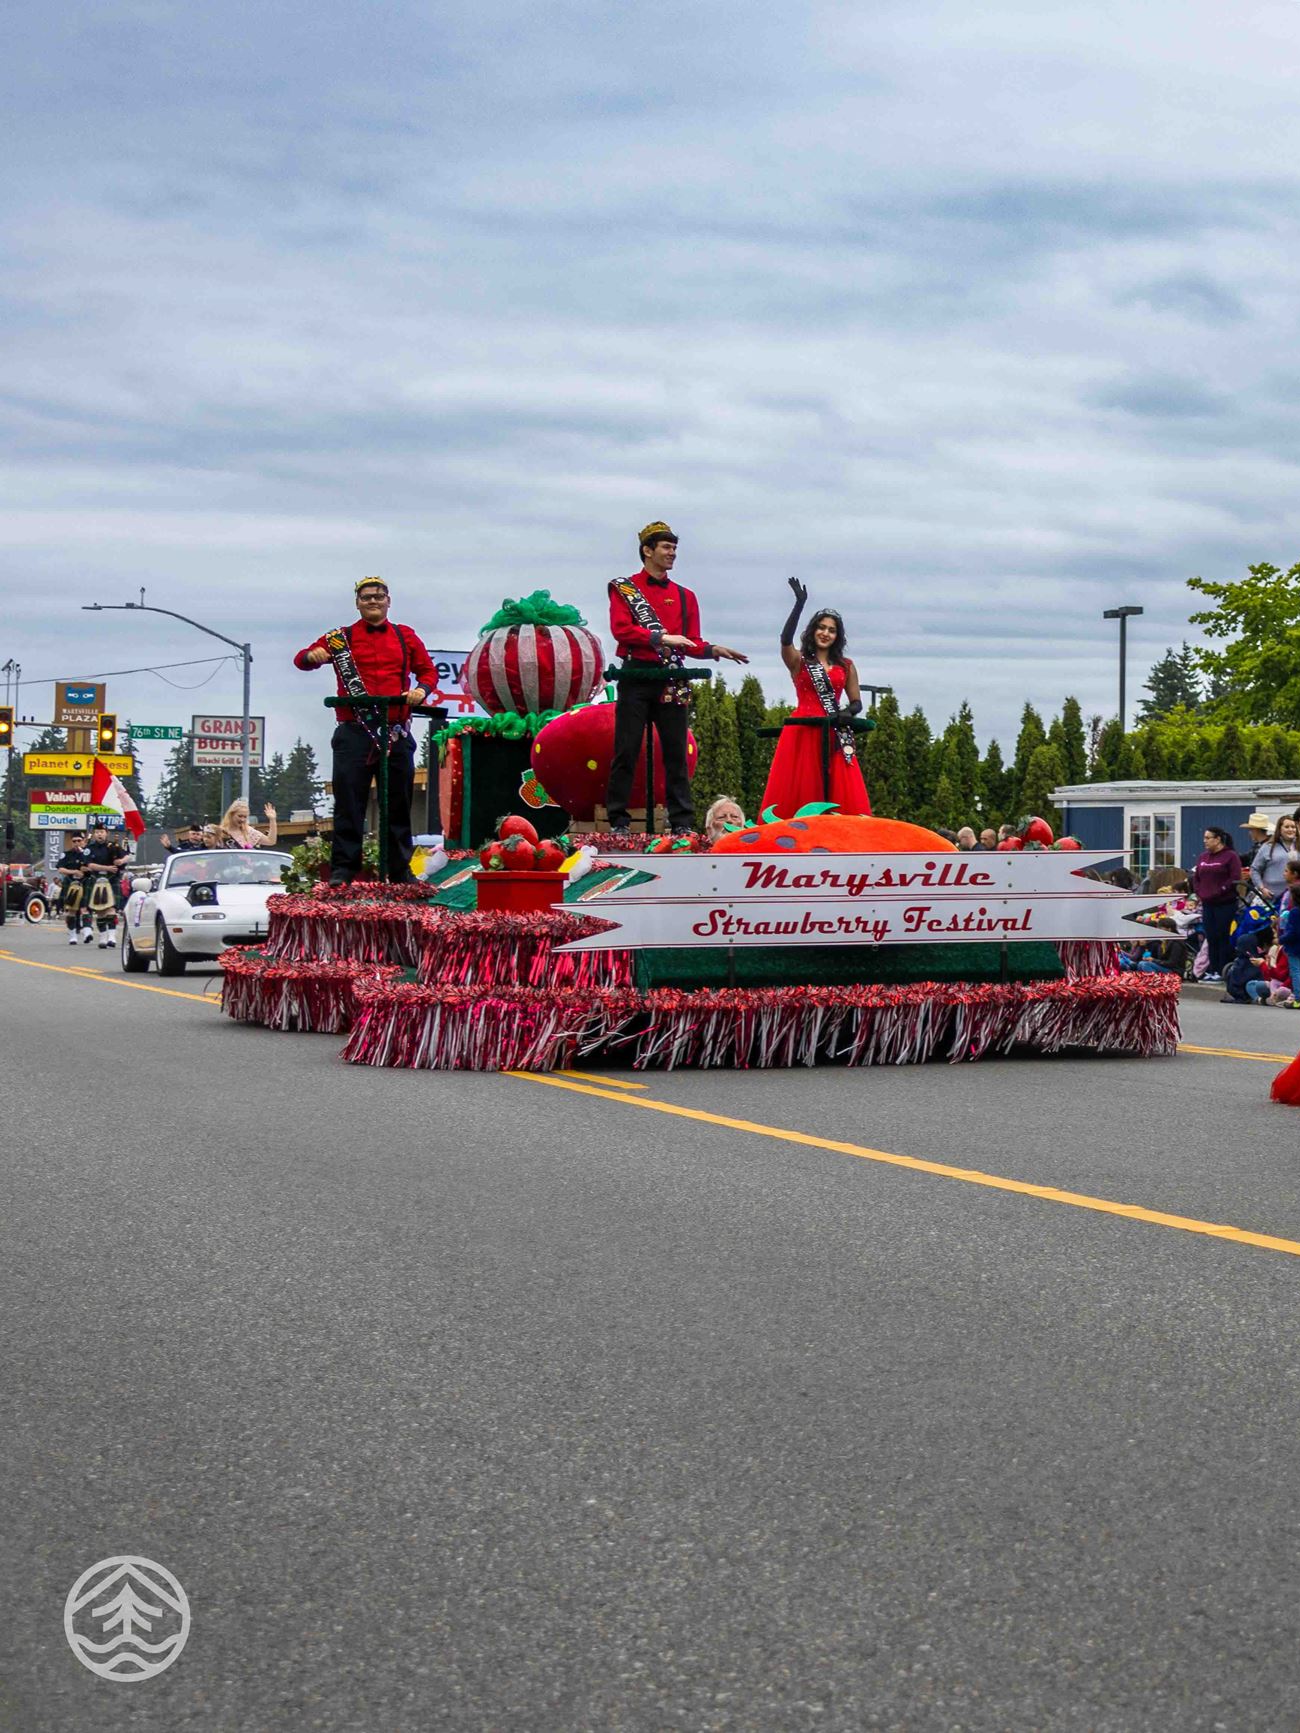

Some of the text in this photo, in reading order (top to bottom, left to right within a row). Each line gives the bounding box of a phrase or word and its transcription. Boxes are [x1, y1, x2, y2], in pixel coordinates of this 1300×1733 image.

[631, 597, 653, 623] King
[335, 650, 352, 677] Prince
[61, 714, 98, 722] PLAZA
[132, 727, 181, 739] 76th St NE
[200, 719, 257, 735] GRAND
[28, 759, 69, 770] planet
[197, 756, 220, 764] Hibachi
[44, 805, 111, 813] Donation Center
[49, 816, 77, 825] Outlet
[48, 831, 60, 870] CHASE
[743, 862, 996, 897] Marysville
[692, 906, 1033, 942] Strawberry Festival
